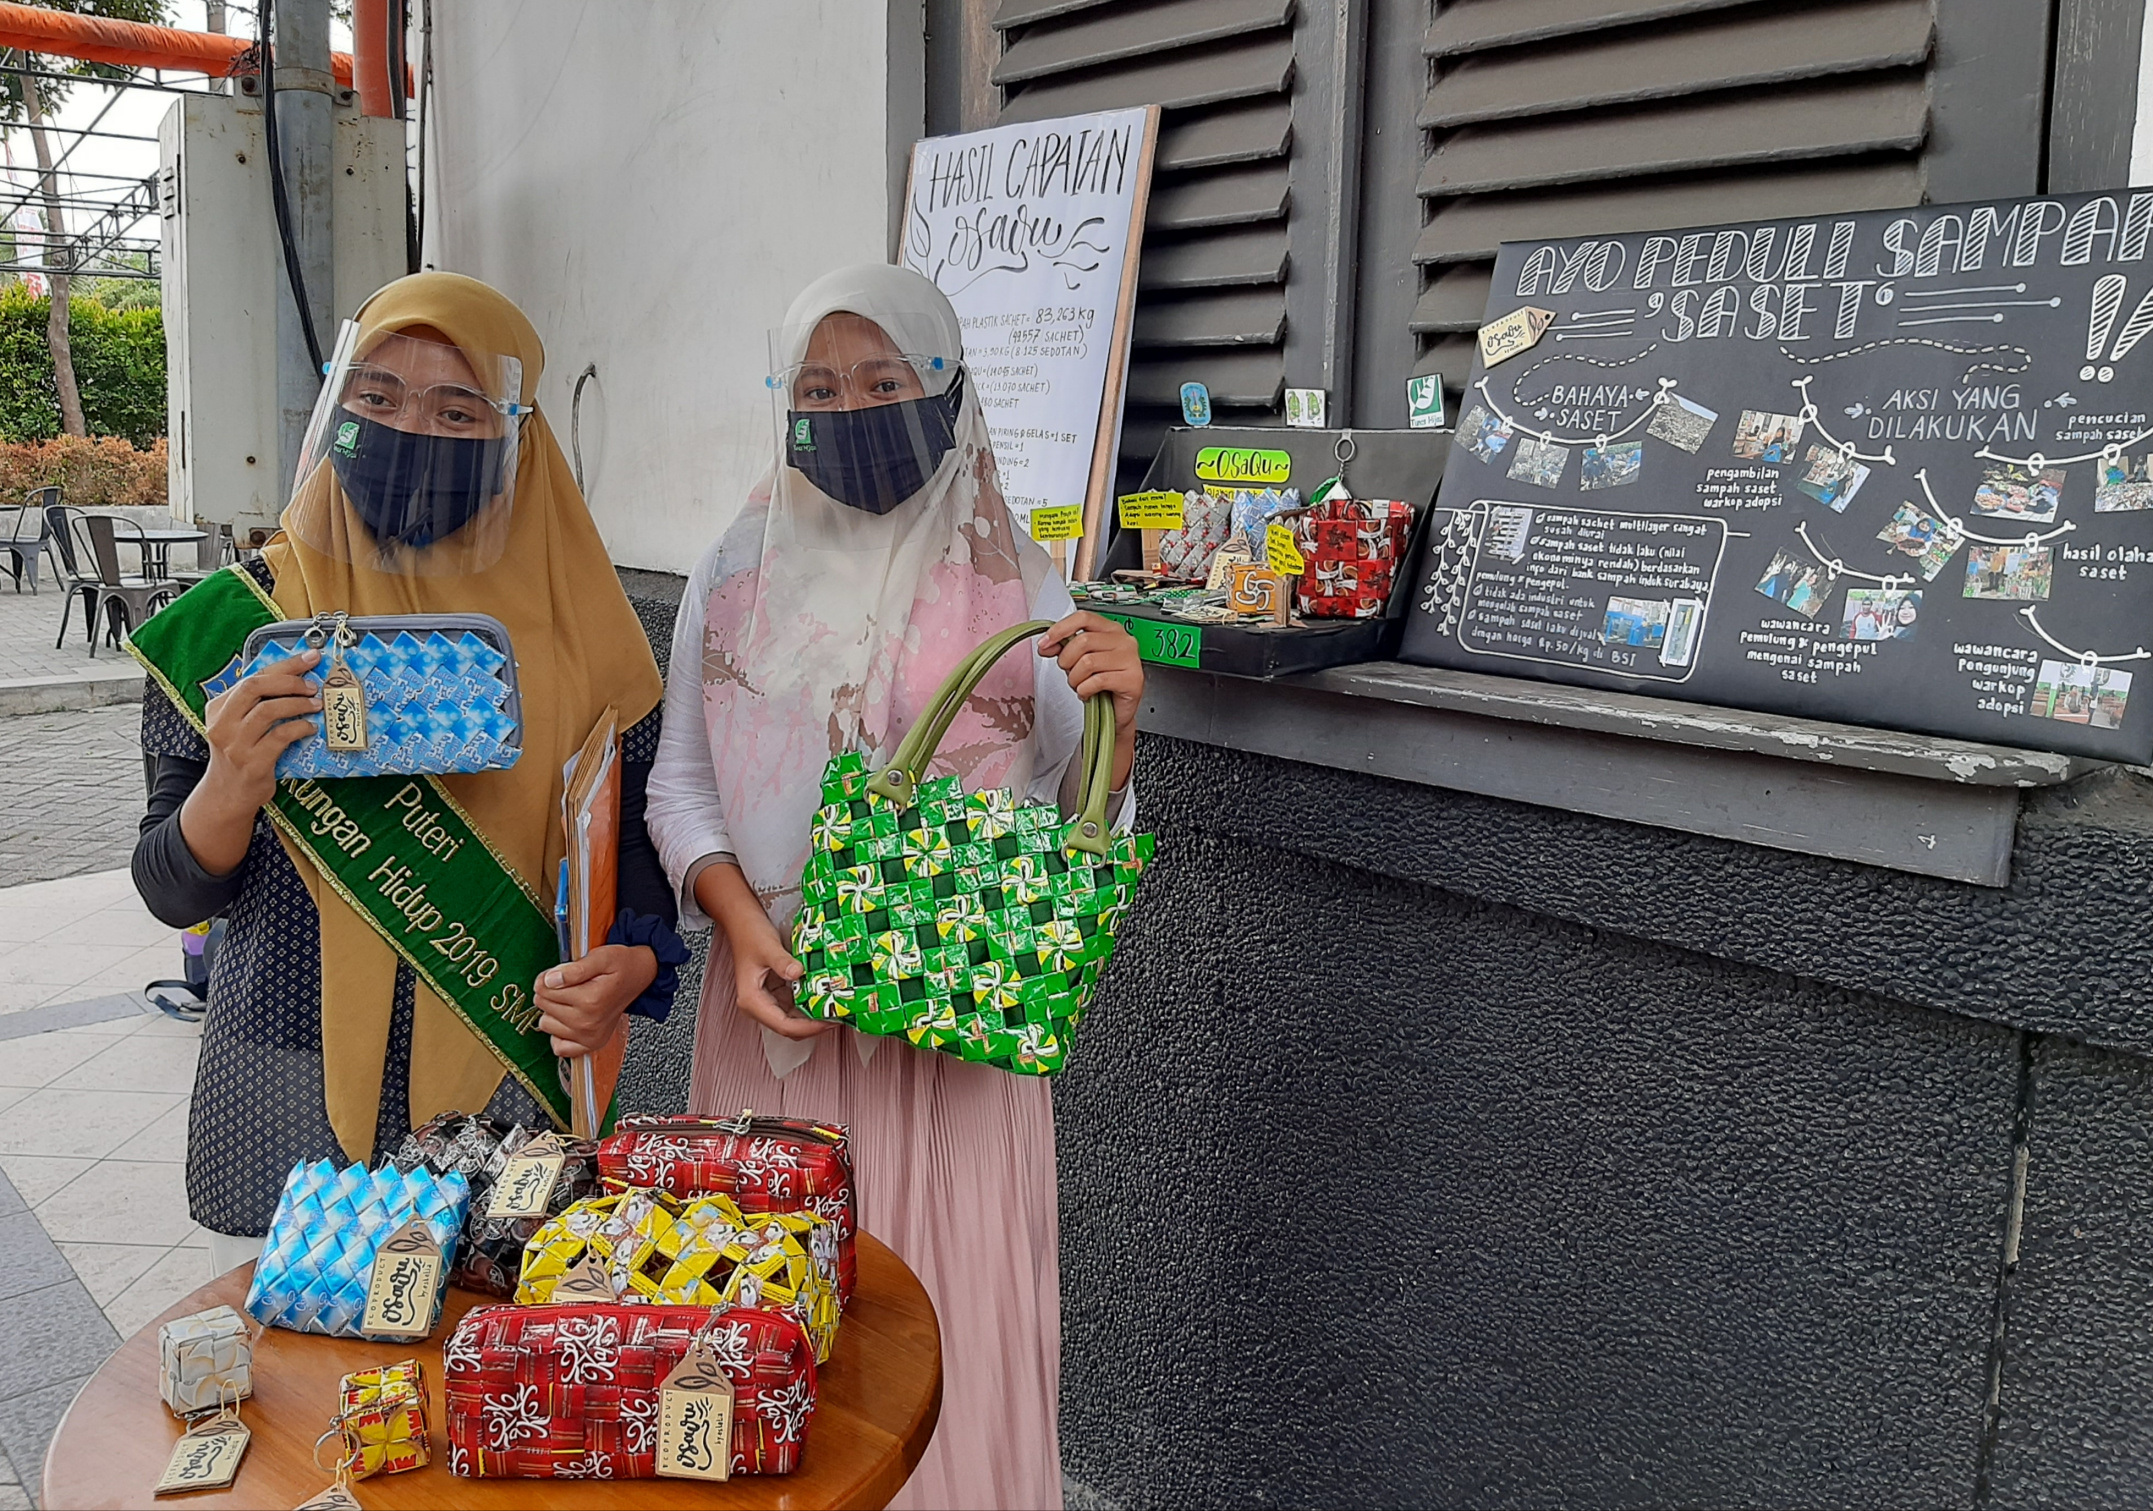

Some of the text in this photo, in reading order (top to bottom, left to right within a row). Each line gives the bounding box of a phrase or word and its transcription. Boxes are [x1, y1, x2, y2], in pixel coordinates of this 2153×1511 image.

[929, 142, 994, 213] HASIL
[1516, 241, 1626, 296] AYO
[1633, 221, 1855, 289] PEDULI
[1551, 385, 1629, 408] BAHAYA
[1882, 384, 2021, 411] AKSI YANG
[1556, 409, 1622, 432] SASET
[1868, 410, 2038, 442] DILAKUKAN
[2068, 412, 2147, 430] pencucian
[1060, 433, 1078, 444] SET
[2055, 430, 2103, 444] sampah
[1706, 467, 1779, 482] pengambilan
[1697, 483, 1777, 497] sampah saset
[1703, 496, 1783, 512] warkop adopsi
[1544, 525, 1572, 536] susah
[1546, 514, 1707, 537] sampah sachet multilayer sangat
[1539, 537, 1575, 553] sampah
[1577, 541, 1604, 553] saset
[1608, 543, 1634, 555] tidak
[1636, 543, 1655, 557] laku
[2063, 543, 2153, 563] hasil olaha
[1532, 550, 1594, 569] ekonominya
[1640, 560, 1700, 575] berdasarkan
[2080, 565, 2128, 581] saset
[1548, 564, 1568, 577] dari
[1571, 567, 1594, 580] bank
[1597, 571, 1636, 588] sampah
[1484, 586, 1507, 599] tidak
[1509, 588, 1526, 601] ada
[1569, 597, 1596, 609] untuk
[1478, 612, 1515, 627] sampah
[1521, 619, 1542, 631] saset
[1546, 622, 1567, 634] laku
[1518, 604, 1550, 619] sampah
[1553, 609, 1584, 621] saset
[1761, 619, 1831, 635] wawancara
[1152, 629, 1196, 659] 382
[1954, 643, 2038, 663] wawancara
[1611, 650, 1637, 667] BSI
[1808, 658, 1862, 677] sampah
[1782, 668, 1818, 684] saset
[1972, 678, 2026, 695] warkop
[1977, 696, 2024, 718] adopsi
[384, 780, 466, 863] Puteri
[368, 855, 444, 934] Hidup
[429, 922, 500, 988] 2019
[367, 1256, 386, 1327] ECOPRODUCT
[662, 1390, 674, 1469] ECOPRODUCT
